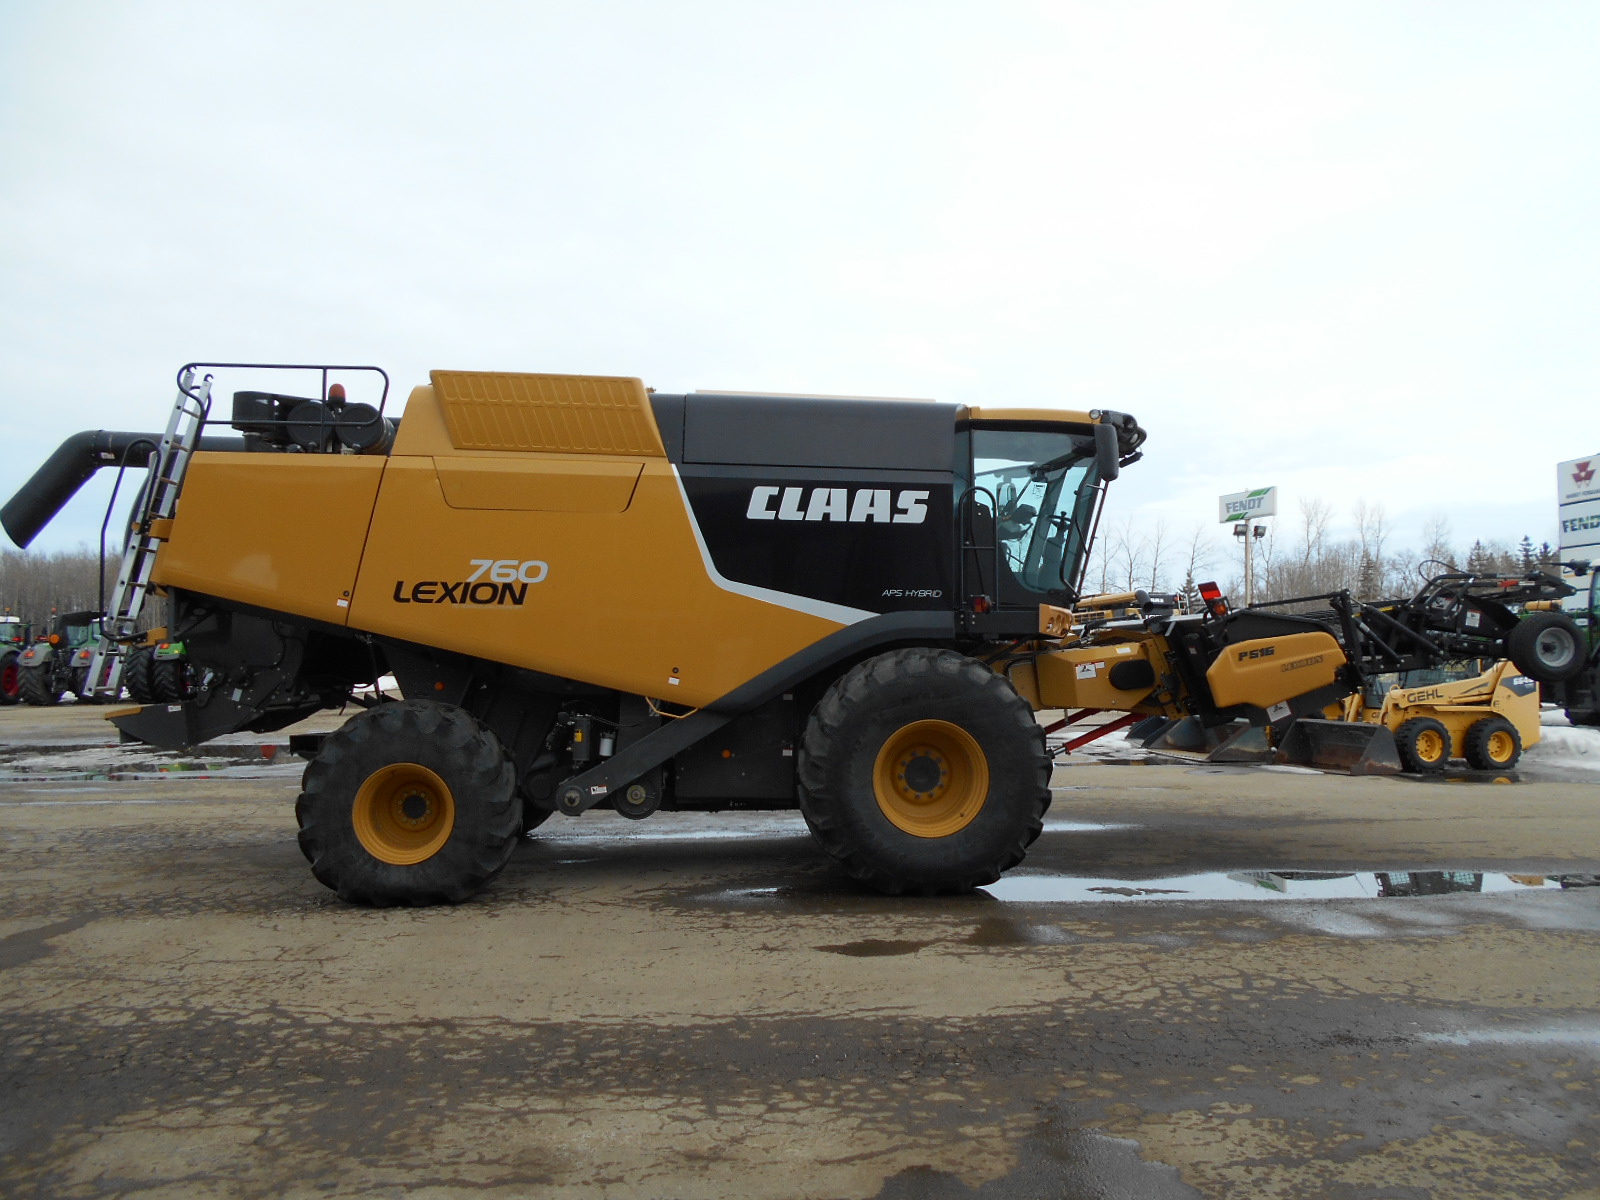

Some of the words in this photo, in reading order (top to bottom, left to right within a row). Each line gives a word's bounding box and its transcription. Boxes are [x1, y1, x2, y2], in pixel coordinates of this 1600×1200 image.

[746, 486, 930, 524] CLAAS
[1225, 497, 1264, 513] FENDT
[466, 559, 548, 584] 760
[393, 581, 528, 605] LEXION
[905, 590, 942, 598] HYBRID
[1406, 689, 1444, 704] GEHL
